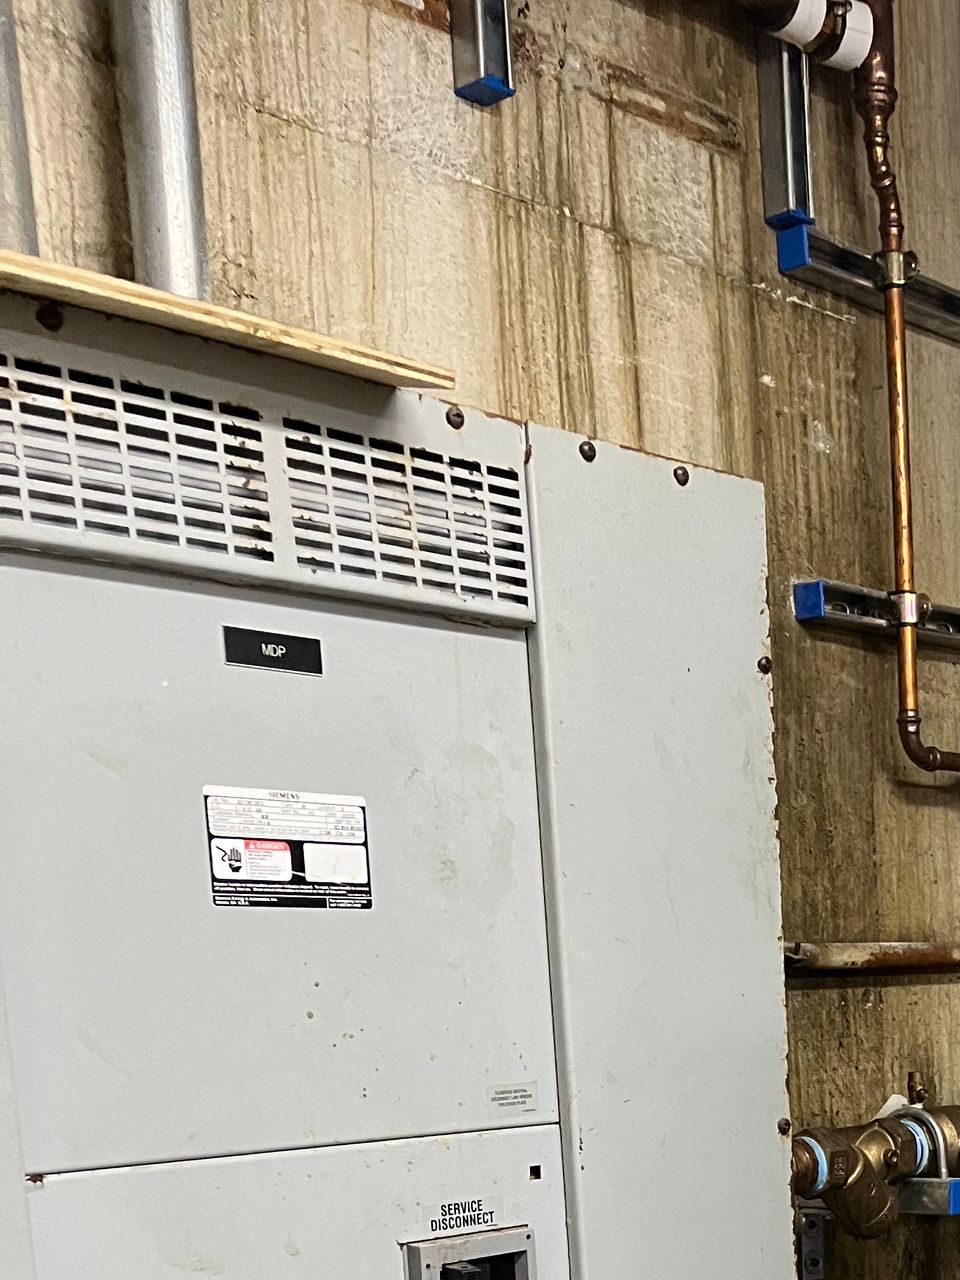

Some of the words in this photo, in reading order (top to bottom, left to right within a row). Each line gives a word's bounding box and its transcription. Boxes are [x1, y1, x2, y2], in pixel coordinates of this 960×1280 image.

[261, 643, 286, 657] MDP
[268, 791, 300, 800] SIEMENS
[440, 1200, 483, 1217] SERVICE
[431, 1211, 495, 1231] DISCONNECT
